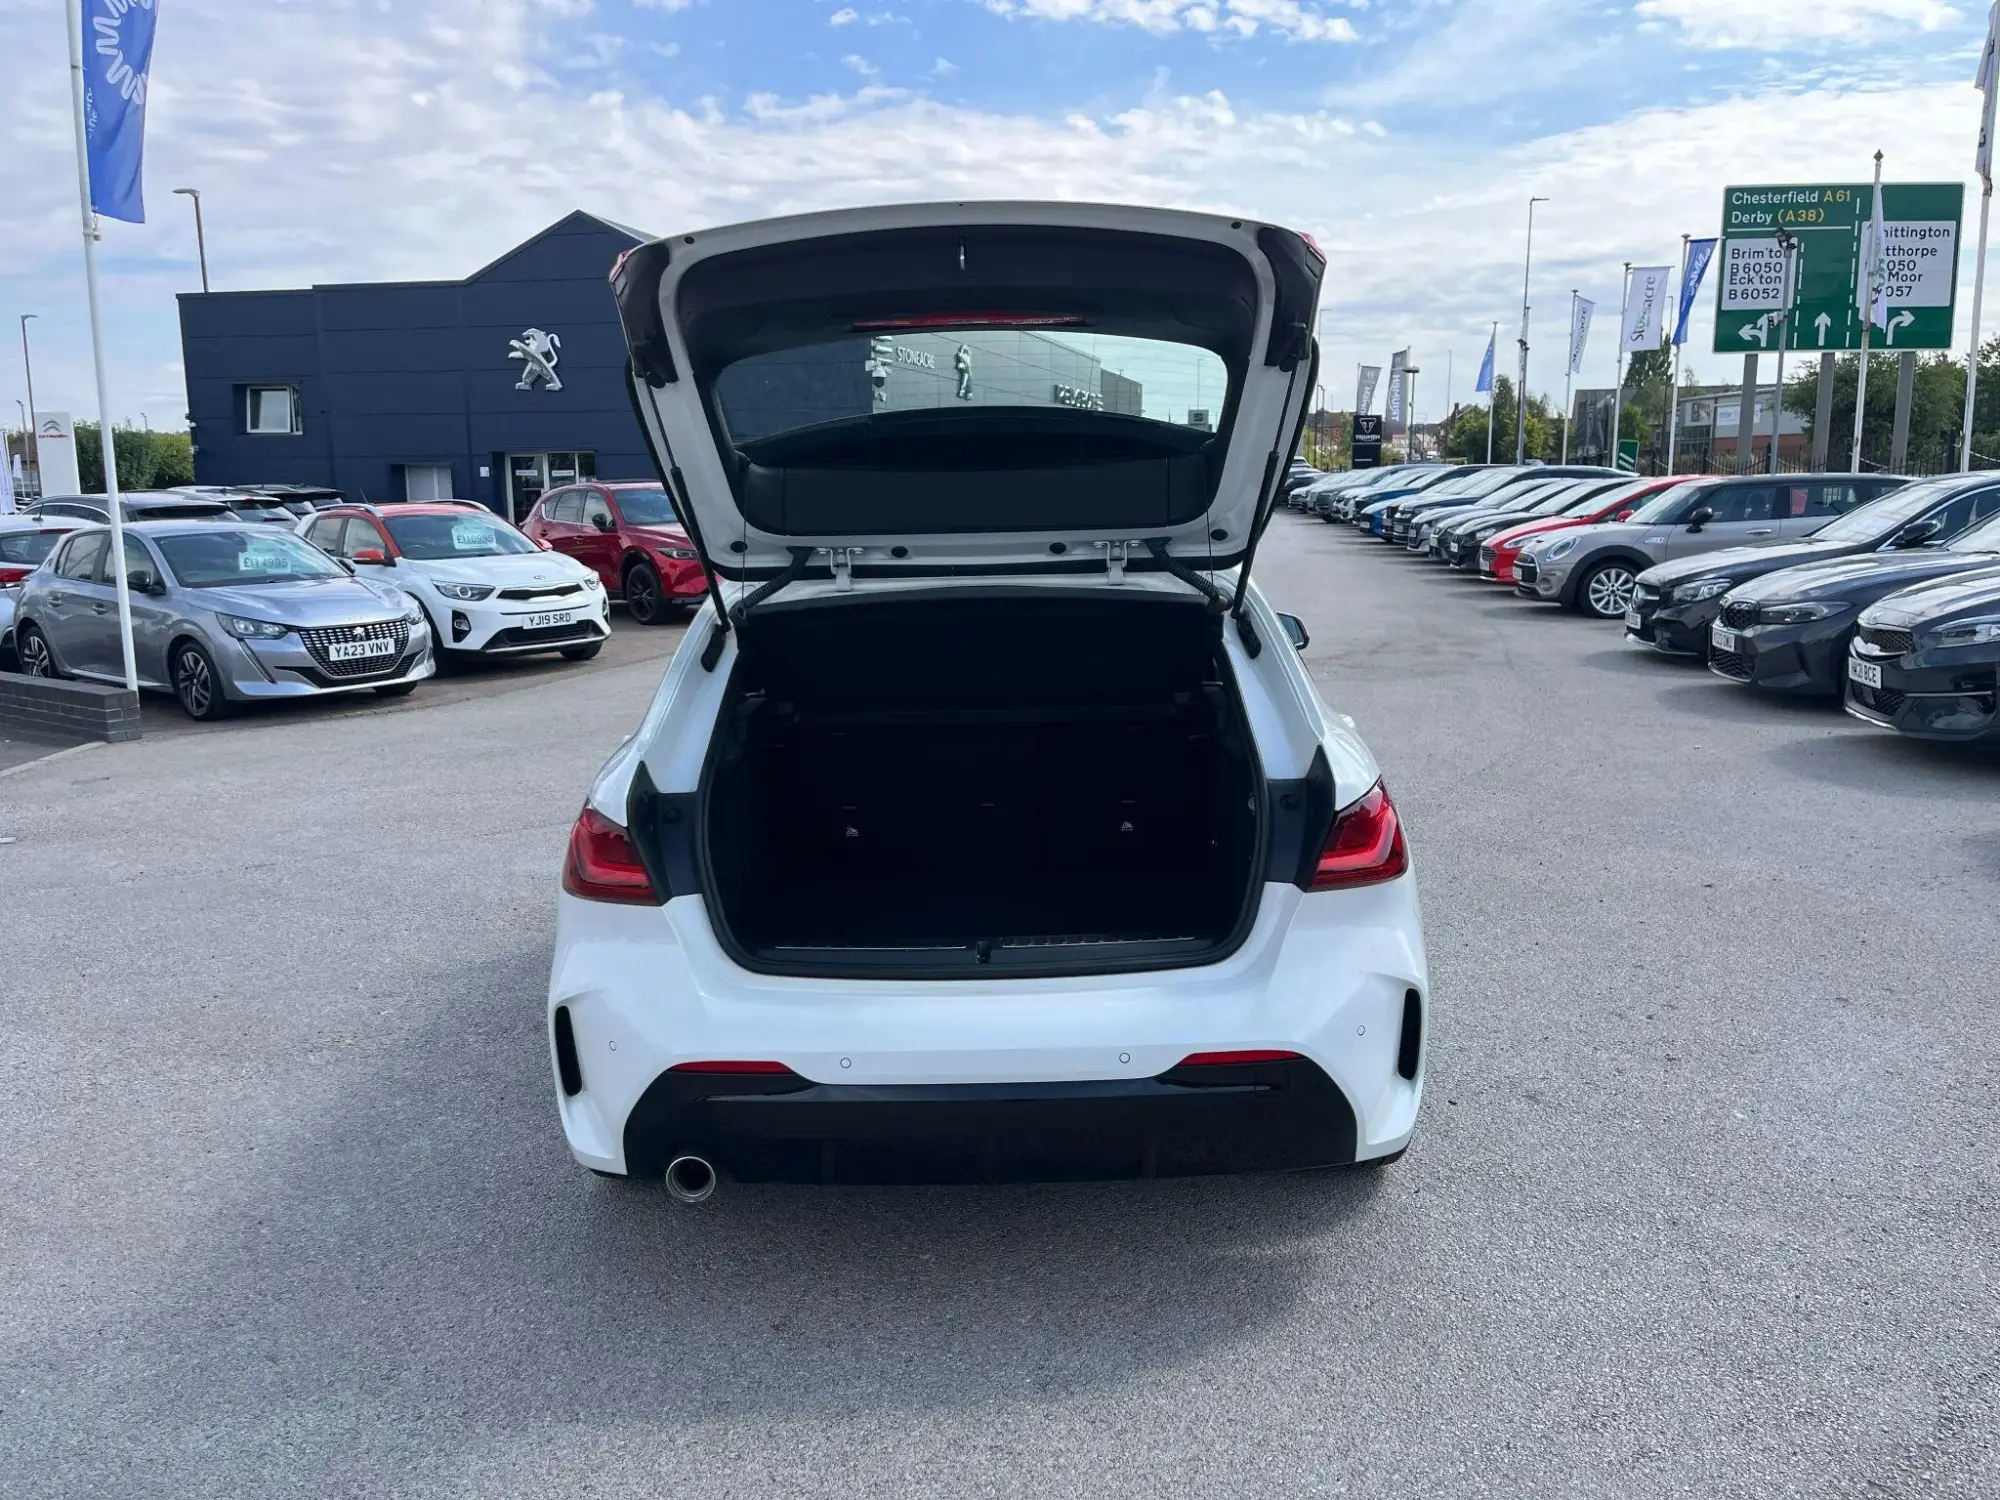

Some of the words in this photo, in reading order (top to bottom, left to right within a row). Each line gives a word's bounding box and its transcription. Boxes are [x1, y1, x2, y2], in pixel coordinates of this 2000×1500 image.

[1731, 190, 1819, 205] Chesterfield
[1731, 211, 1773, 225] Derby
[1731, 247, 1786, 260] Brim'to
[1885, 245, 1938, 258] tthorpe
[1886, 260, 1917, 272] 050
[1885, 285, 1913, 297] 057
[896, 346, 936, 369] STONEACRE
[529, 614, 551, 626] YJ19
[553, 612, 571, 624] SRD
[334, 643, 366, 658] YA23
[368, 641, 389, 654] VNV
[1864, 664, 1877, 685] BCE
